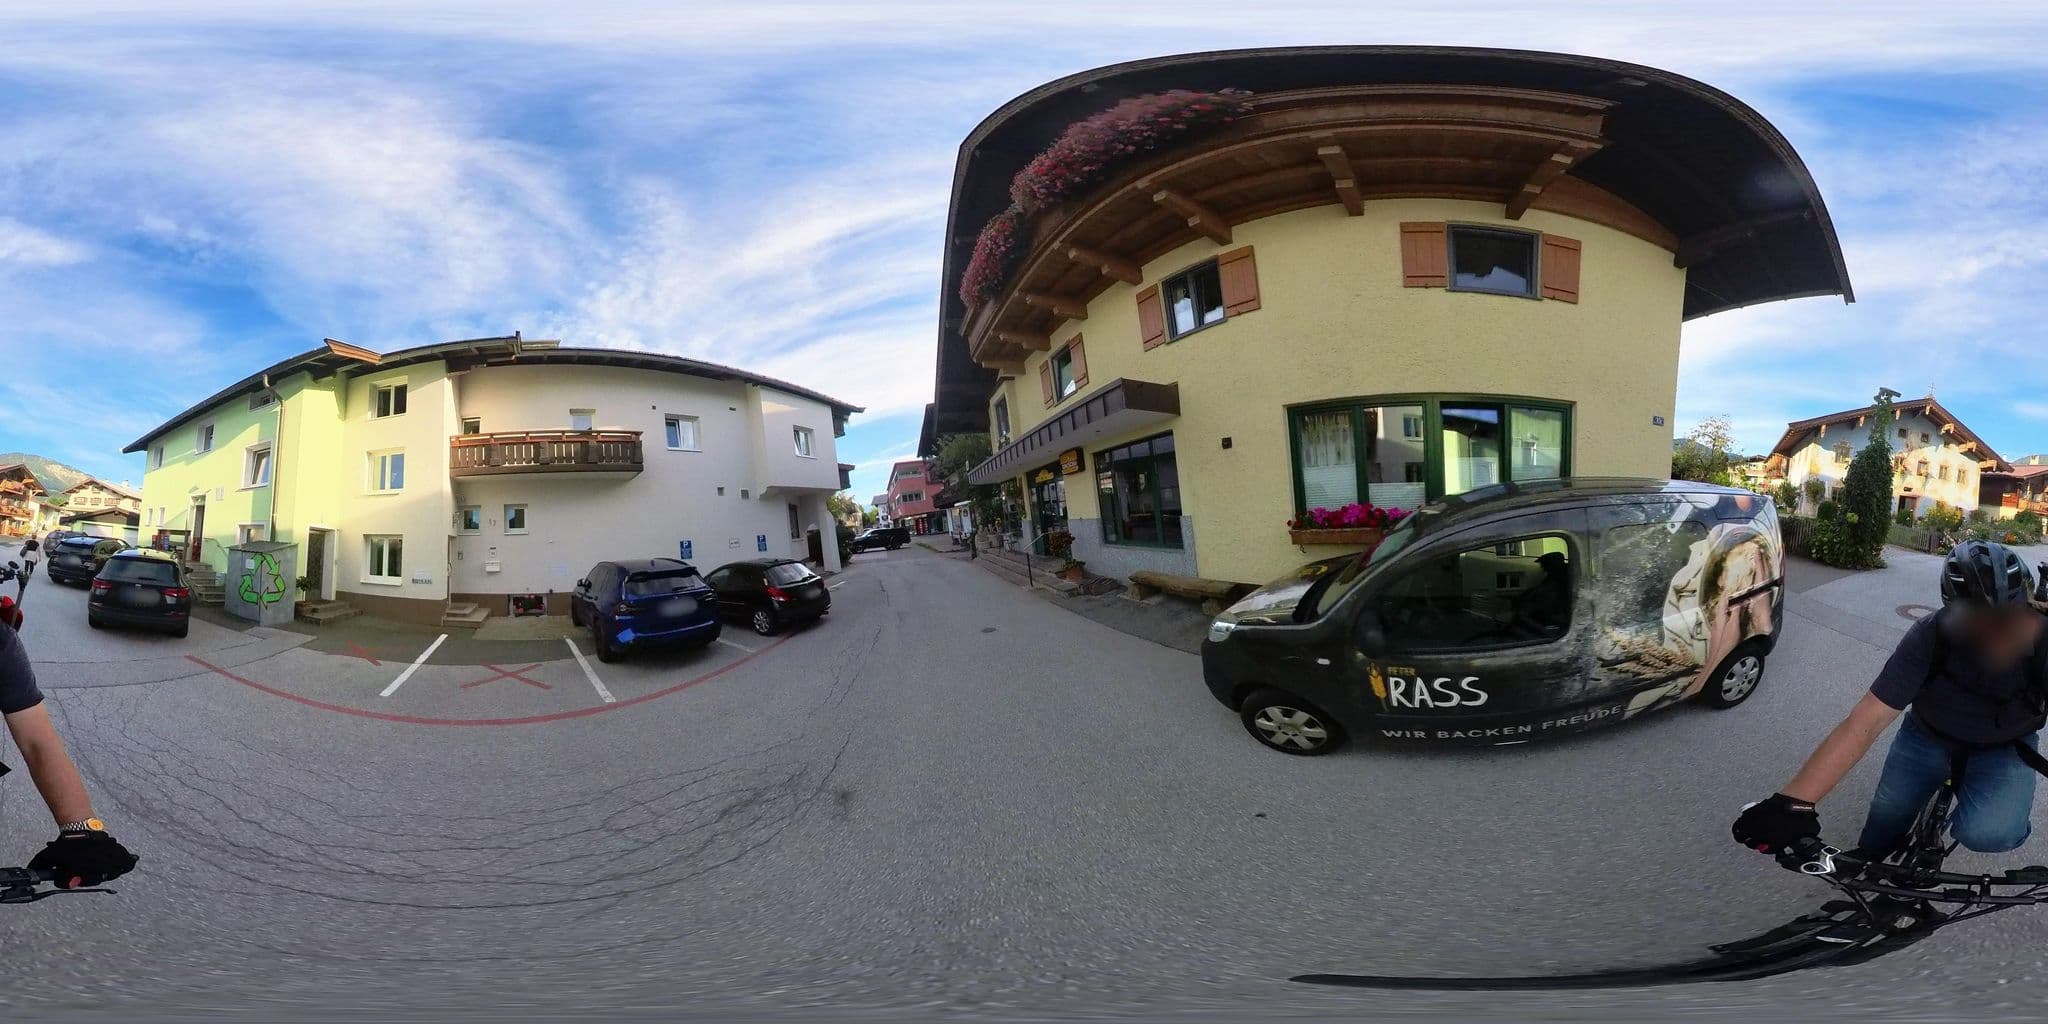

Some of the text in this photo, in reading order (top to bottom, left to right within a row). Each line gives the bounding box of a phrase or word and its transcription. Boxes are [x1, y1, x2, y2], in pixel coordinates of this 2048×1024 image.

[1389, 676, 1489, 708] RASS
[1381, 704, 1622, 739] WIR BACKEN FREUDE
